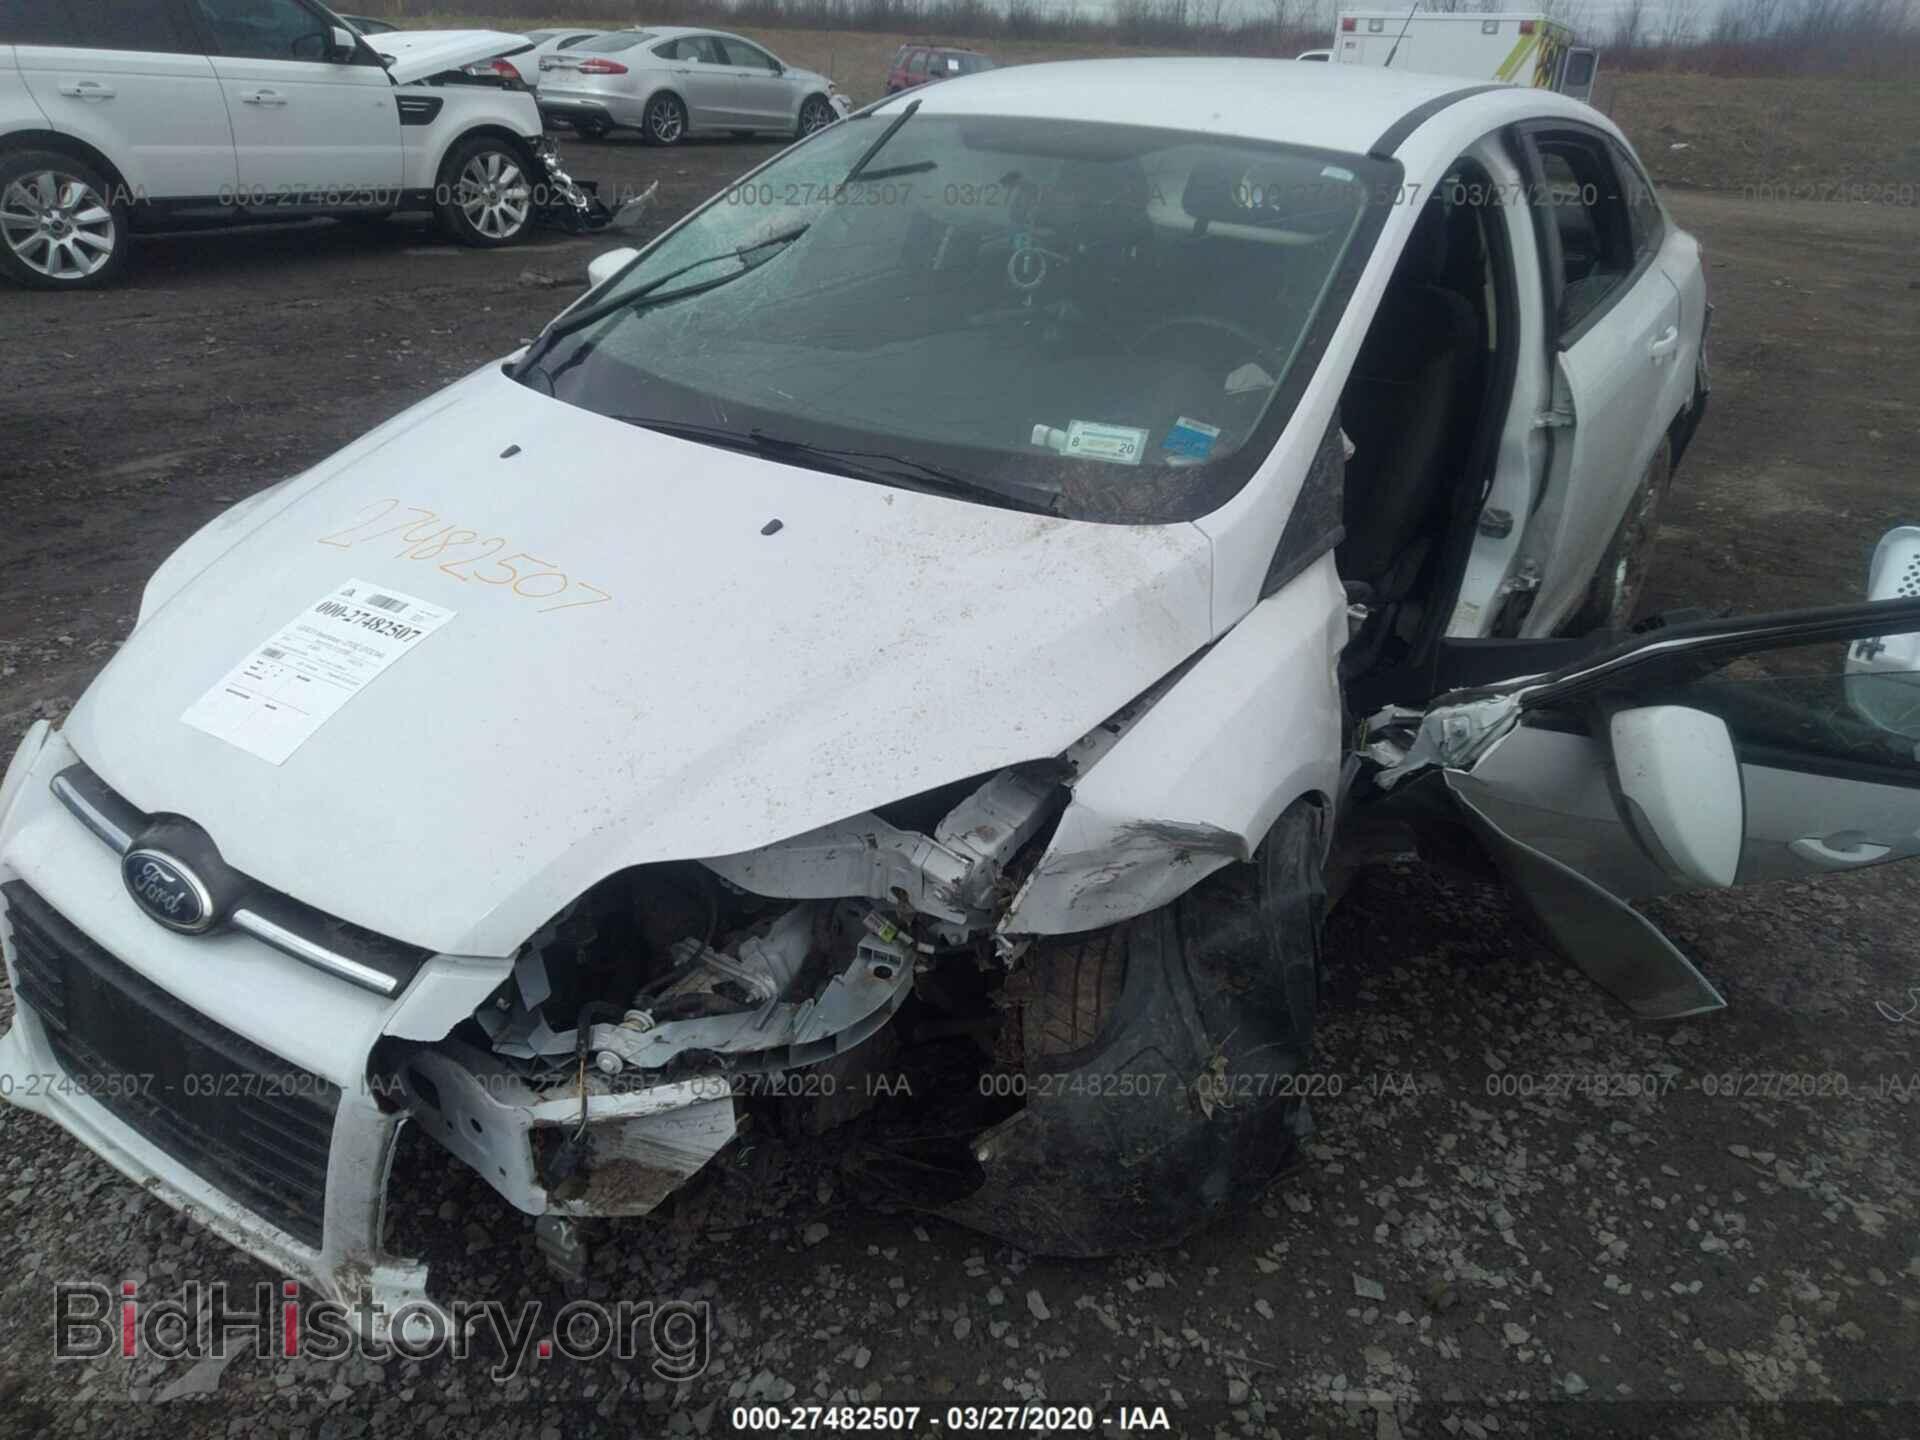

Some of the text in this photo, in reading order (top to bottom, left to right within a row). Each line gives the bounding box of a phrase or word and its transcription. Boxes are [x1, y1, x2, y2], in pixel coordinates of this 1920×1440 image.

[1118, 443, 1135, 454] 20
[317, 498, 612, 613] 27482507
[315, 600, 422, 643] 000-27482507
[135, 862, 186, 913] Ford
